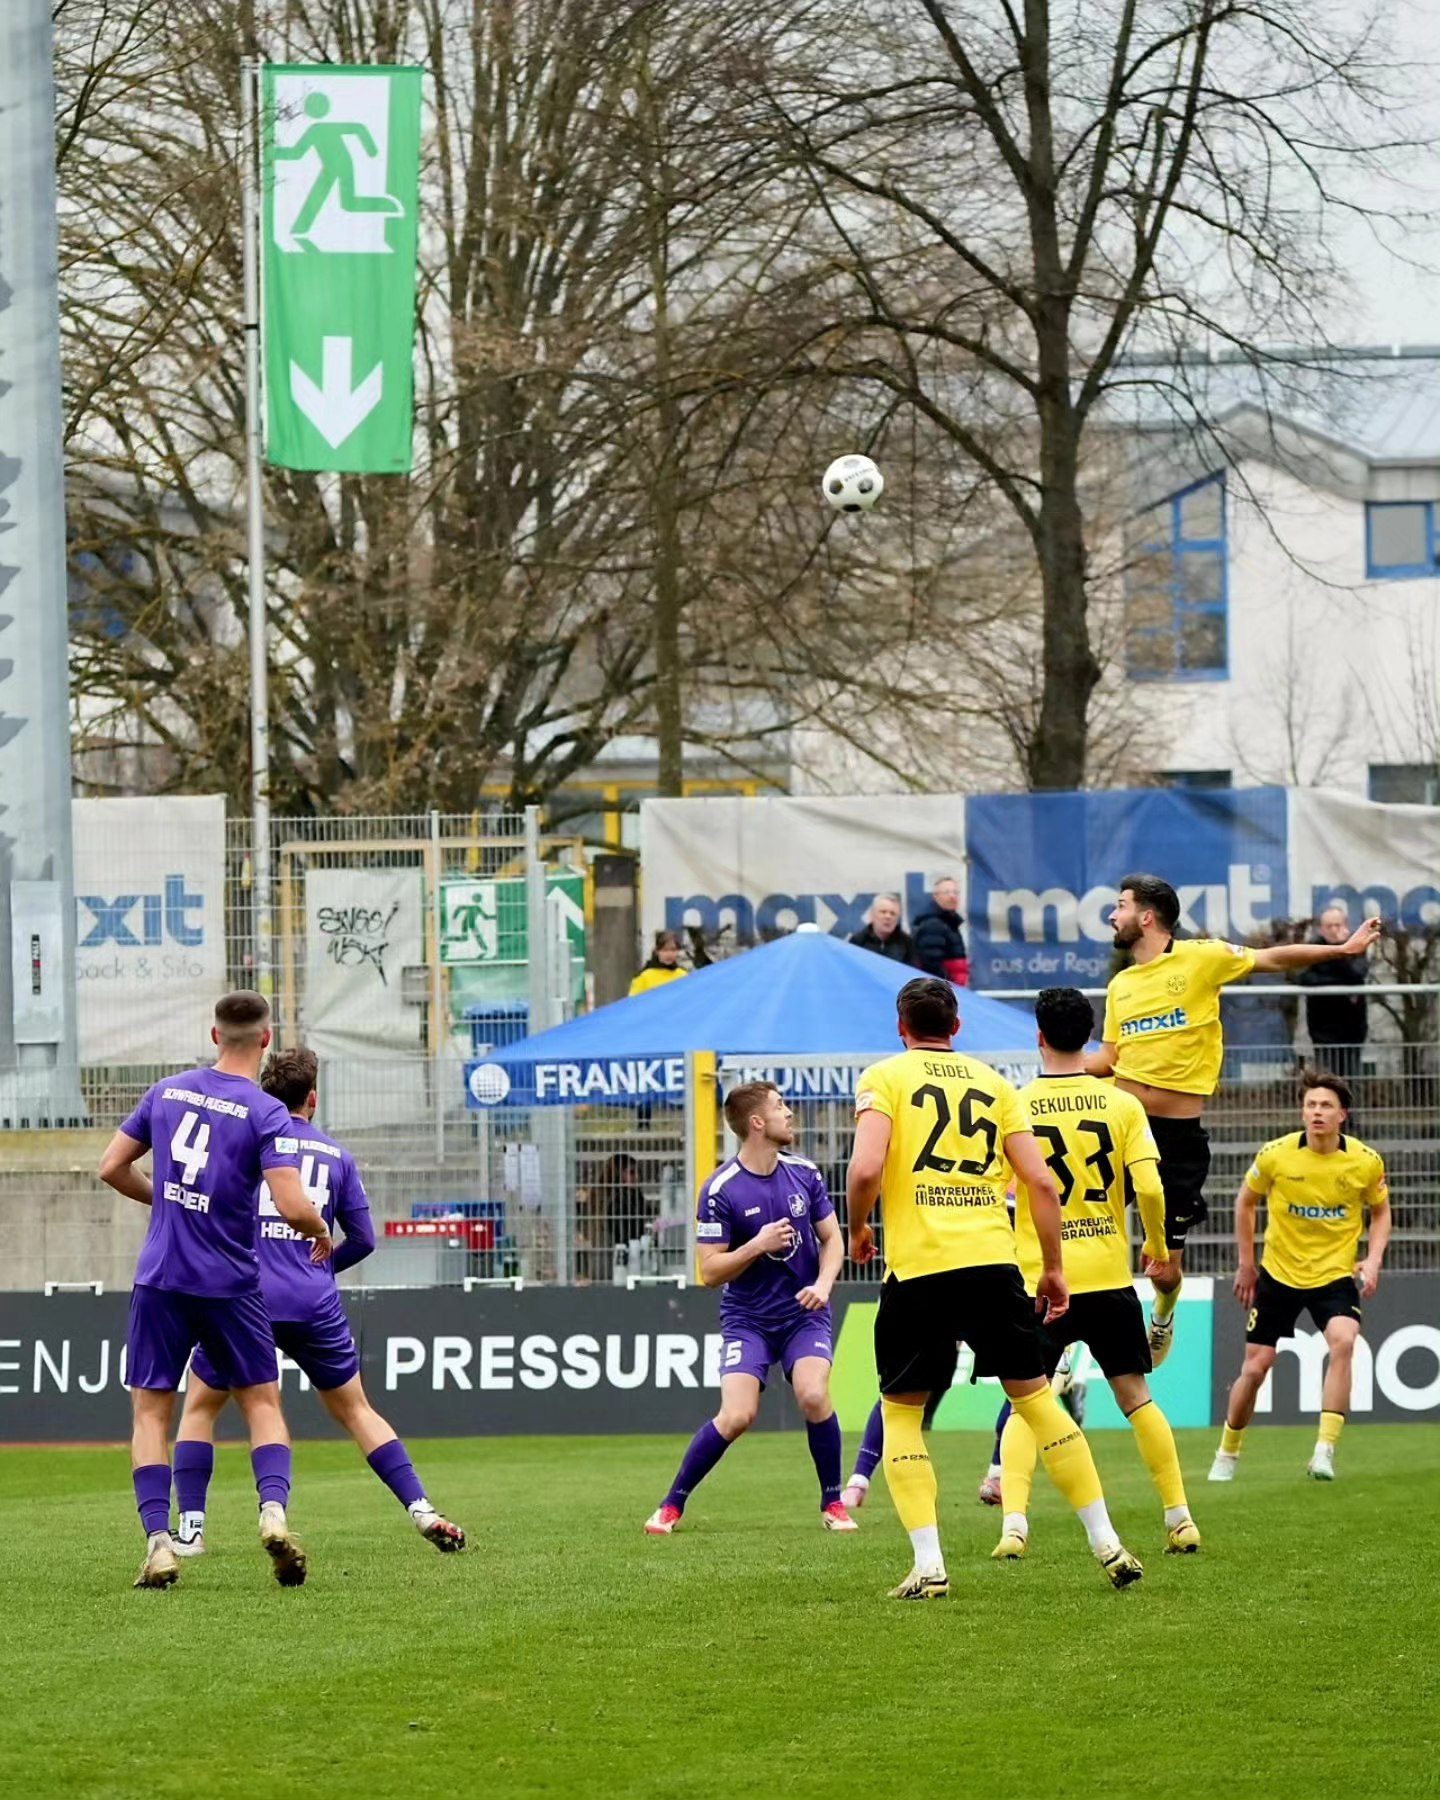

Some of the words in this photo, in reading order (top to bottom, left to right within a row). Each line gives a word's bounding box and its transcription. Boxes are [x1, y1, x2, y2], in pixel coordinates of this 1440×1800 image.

[74, 874, 203, 947] xit
[1028, 951, 1060, 974] der
[1065, 951, 1110, 978] Regi
[1121, 1007, 1186, 1037] maxit
[535, 1058, 684, 1098] FRANKE
[923, 1061, 974, 1080] SEIDEL
[1030, 1094, 1107, 1116] SEKULOVIC
[911, 1083, 997, 1176] 25
[170, 1111, 210, 1185] 4
[1031, 1119, 1116, 1206] 33
[927, 1185, 994, 1197] BAYREUTHER
[928, 1194, 997, 1207] BRAUHAUS
[1288, 1203, 1346, 1218] maxit
[261, 1221, 316, 1242] HER
[725, 1340, 742, 1367] 5
